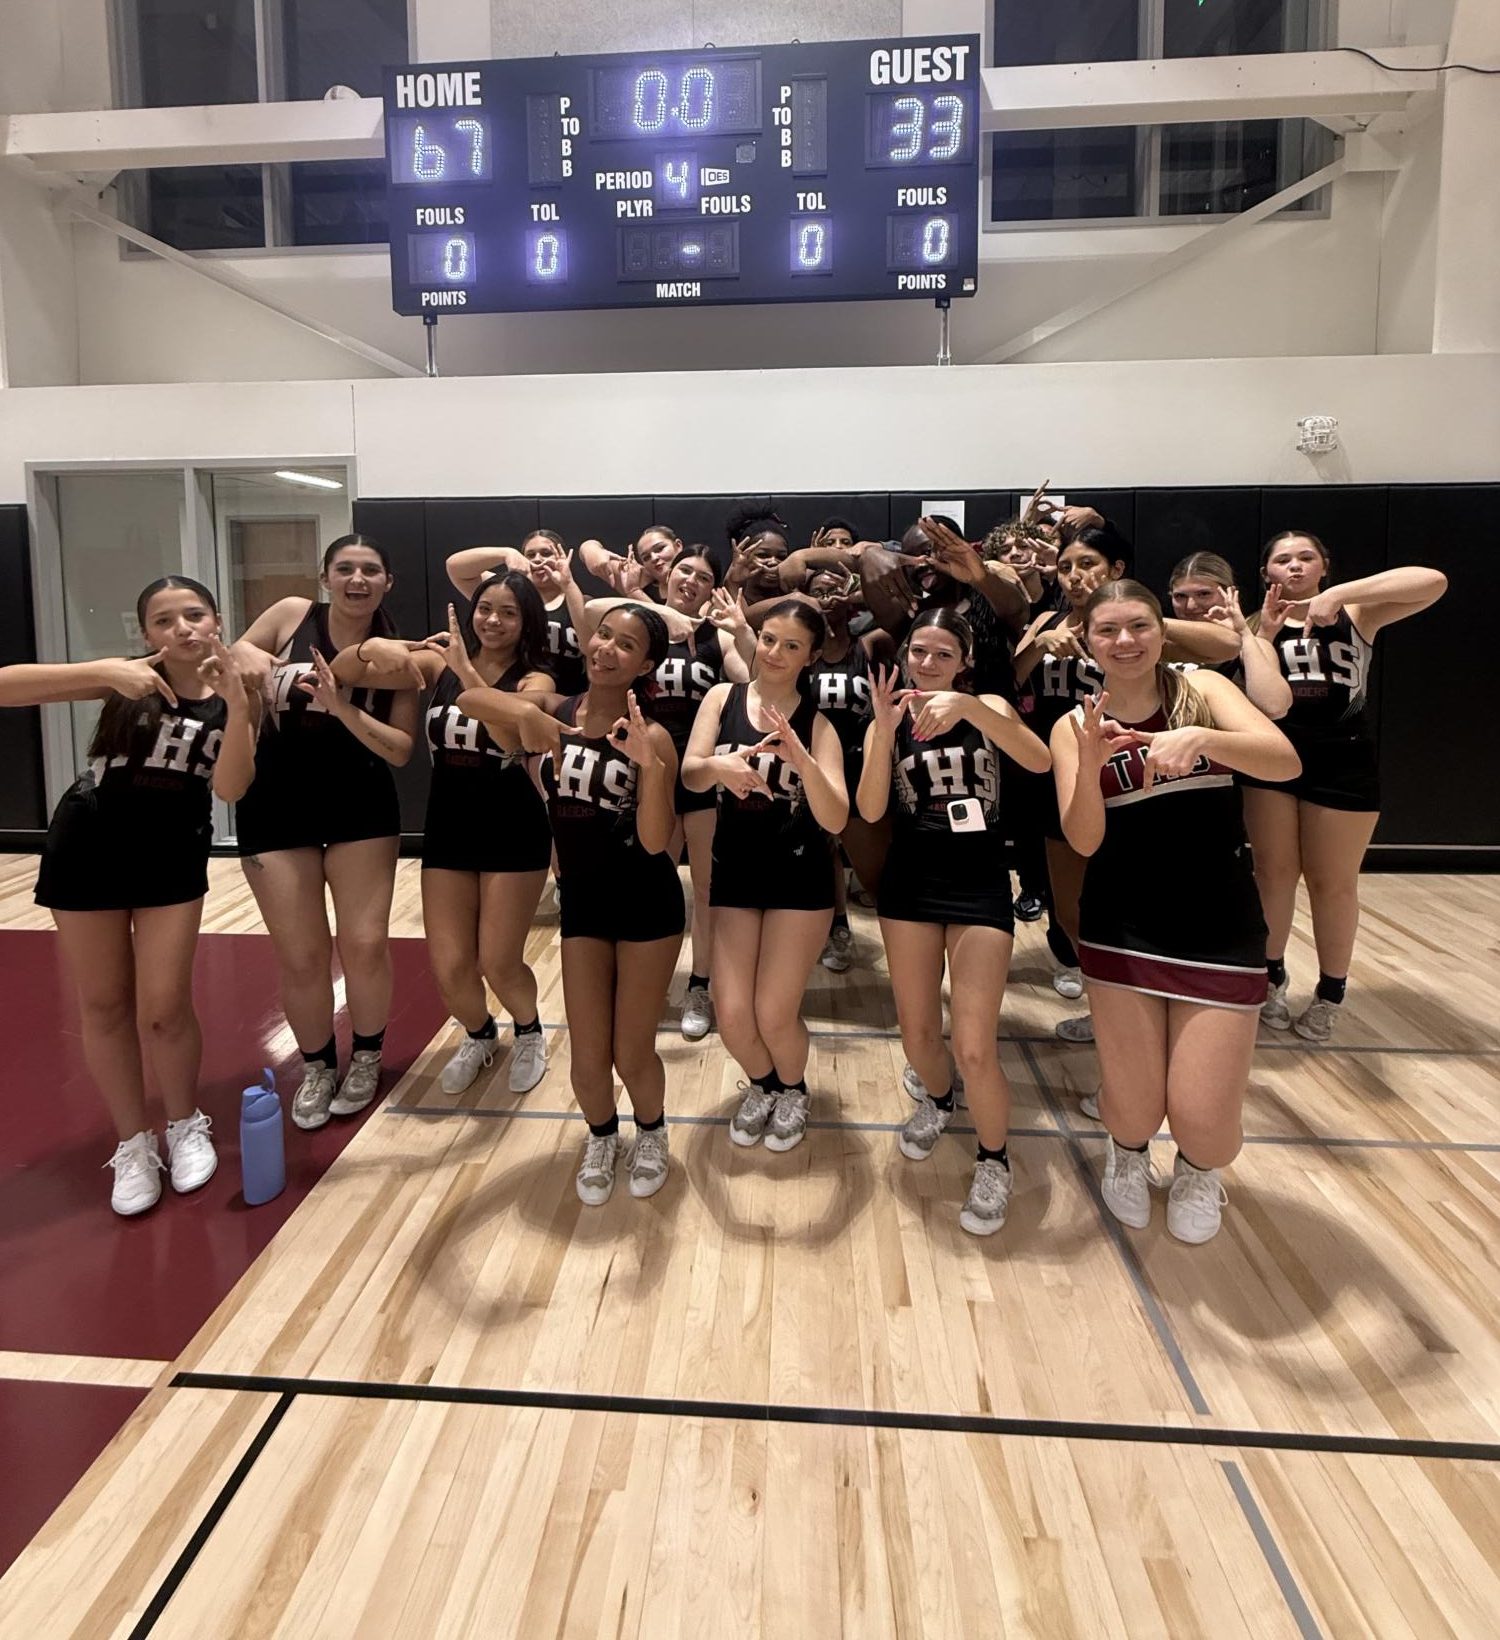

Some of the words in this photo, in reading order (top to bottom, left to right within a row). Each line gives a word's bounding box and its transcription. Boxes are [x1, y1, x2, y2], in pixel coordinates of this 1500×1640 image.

[870, 46, 970, 85] GUEST
[396, 72, 482, 108] HOME
[780, 86, 791, 104] P
[560, 97, 571, 114] P
[772, 107, 792, 125] TO
[561, 117, 580, 136] TO
[781, 128, 792, 146] B
[890, 95, 964, 160] 33
[561, 139, 572, 157] B
[781, 150, 792, 167] B
[562, 160, 573, 177] B
[595, 171, 653, 191] PERIOD
[665, 161, 689, 199] 4
[616, 199, 653, 218] PLYR
[701, 195, 751, 215] FOULS
[797, 192, 826, 211] TOL
[897, 187, 947, 207] FOULS
[416, 207, 465, 226] FOULS
[531, 204, 560, 222] TOL
[799, 223, 824, 268] 0
[922, 218, 950, 263] 0
[444, 239, 468, 280] 0
[536, 234, 559, 275] 0
[656, 282, 700, 299] MATCH
[898, 274, 946, 290] POINTS
[421, 290, 467, 307] POINTS
[1280, 638, 1359, 689] HS
[655, 657, 716, 701] HS
[1042, 652, 1105, 705] HS
[809, 672, 872, 716] HS
[110, 711, 224, 781] HS
[557, 743, 638, 813] HS
[896, 746, 998, 804] THS
